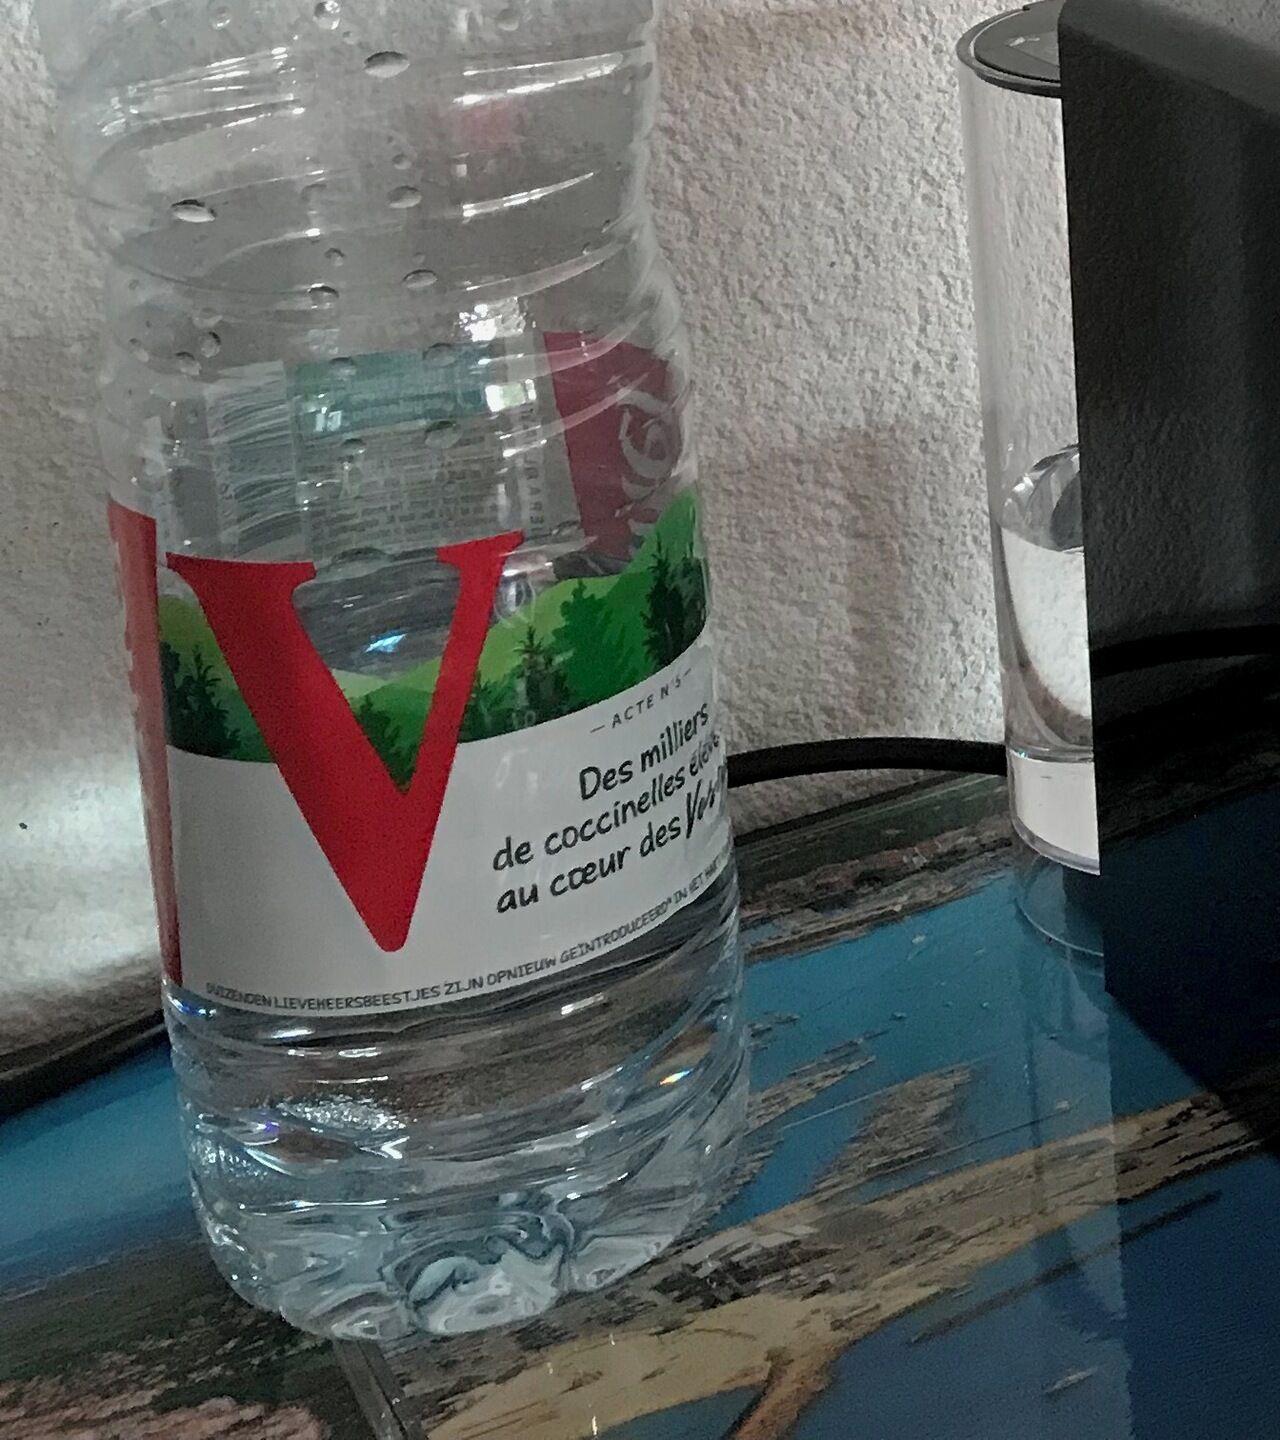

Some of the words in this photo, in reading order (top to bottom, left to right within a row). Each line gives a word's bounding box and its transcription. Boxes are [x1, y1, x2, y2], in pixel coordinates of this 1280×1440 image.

[165, 528, 525, 953] V
[579, 759, 634, 801] Des
[640, 702, 710, 773] milliers
[611, 693, 654, 729] ACTE
[492, 835, 535, 872] de
[543, 764, 686, 856] coccinelles
[496, 883, 540, 914] au
[549, 845, 632, 898] cœur
[638, 815, 682, 859] des
[273, 985, 440, 1011] LIEVEHEERSBEESTJES
[444, 976, 484, 996] ZIJN
[487, 957, 558, 986] OPNIEUW
